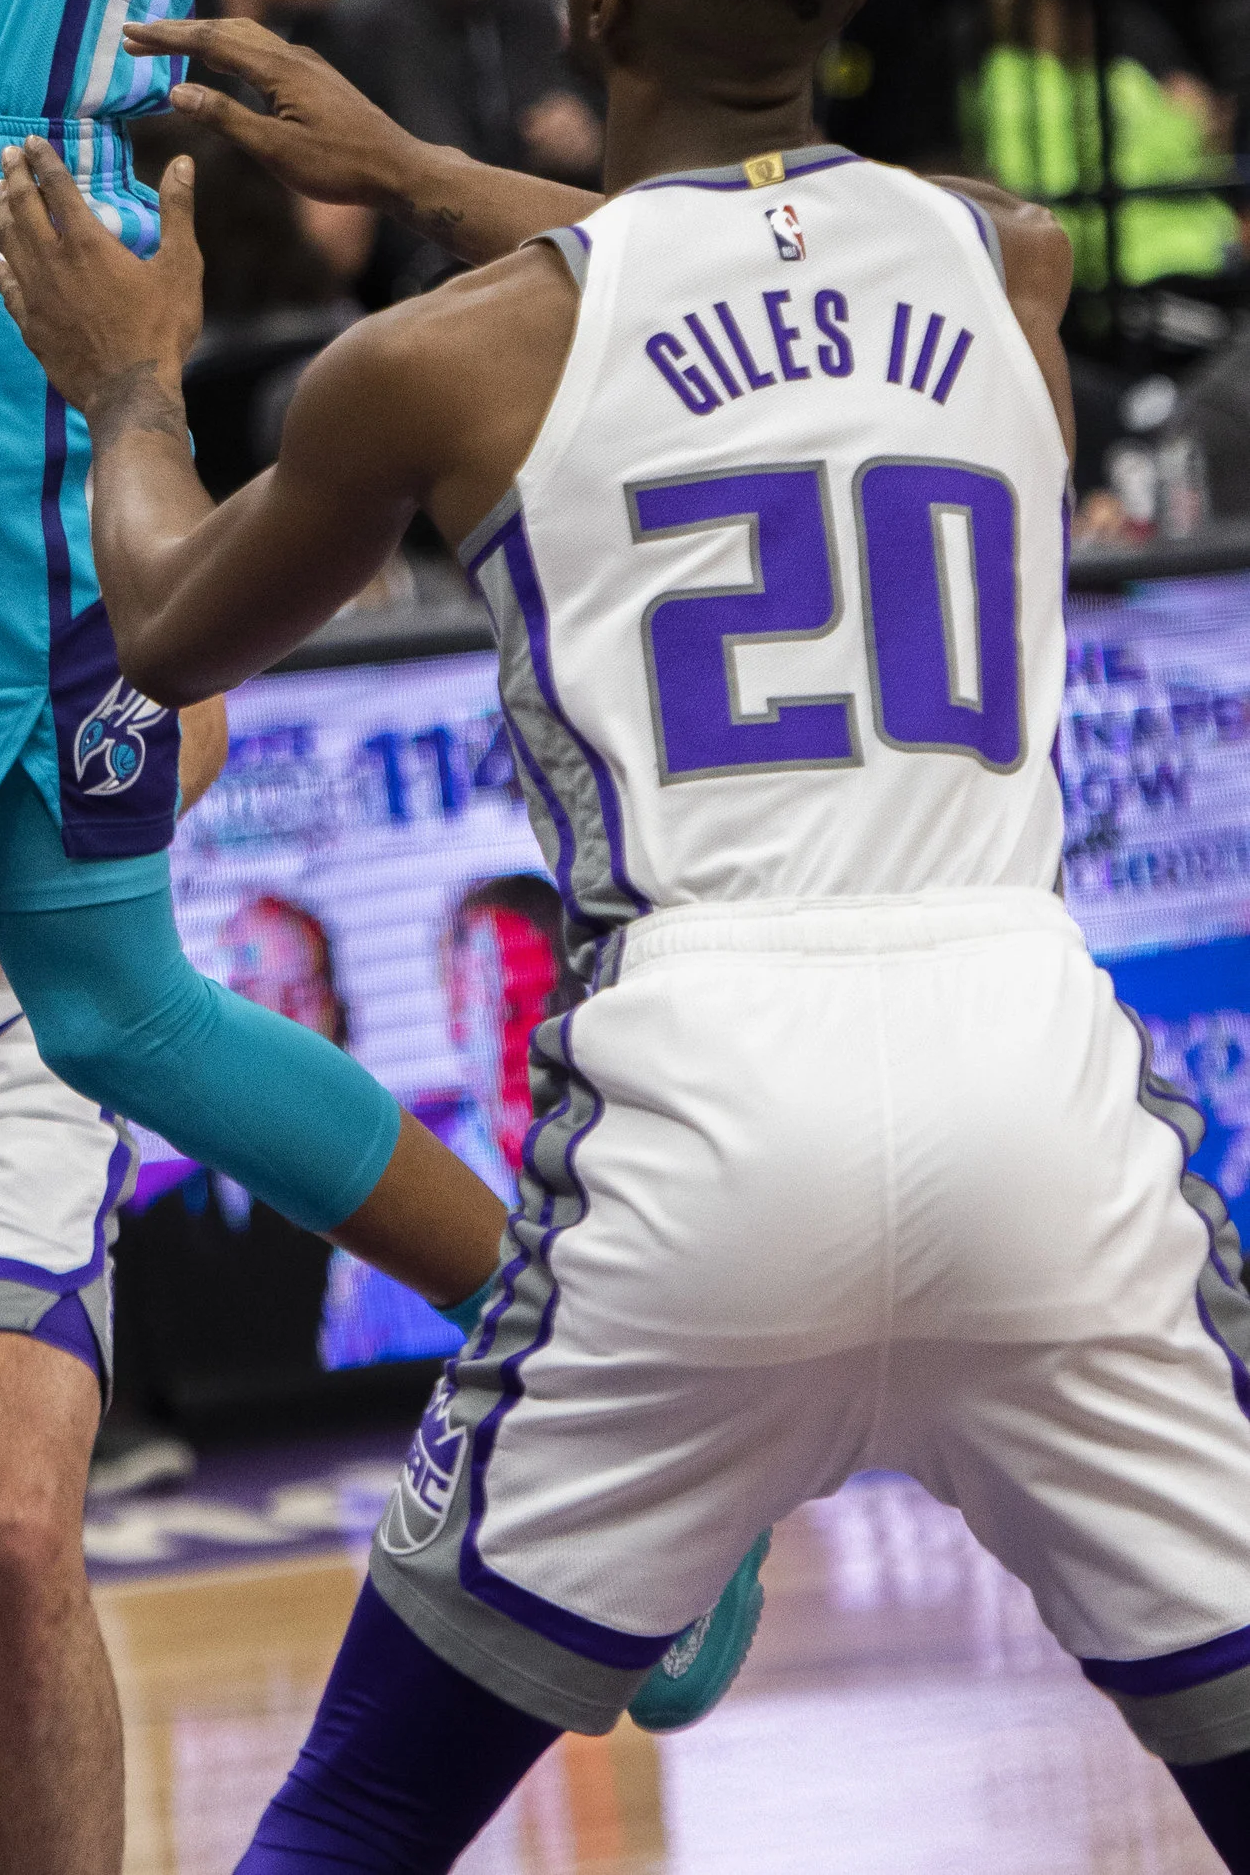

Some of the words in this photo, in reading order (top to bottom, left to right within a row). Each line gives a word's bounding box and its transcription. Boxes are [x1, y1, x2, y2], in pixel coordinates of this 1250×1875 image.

[645, 288, 854, 416] GILES
[886, 302, 975, 406] III
[623, 454, 1027, 788] 20
